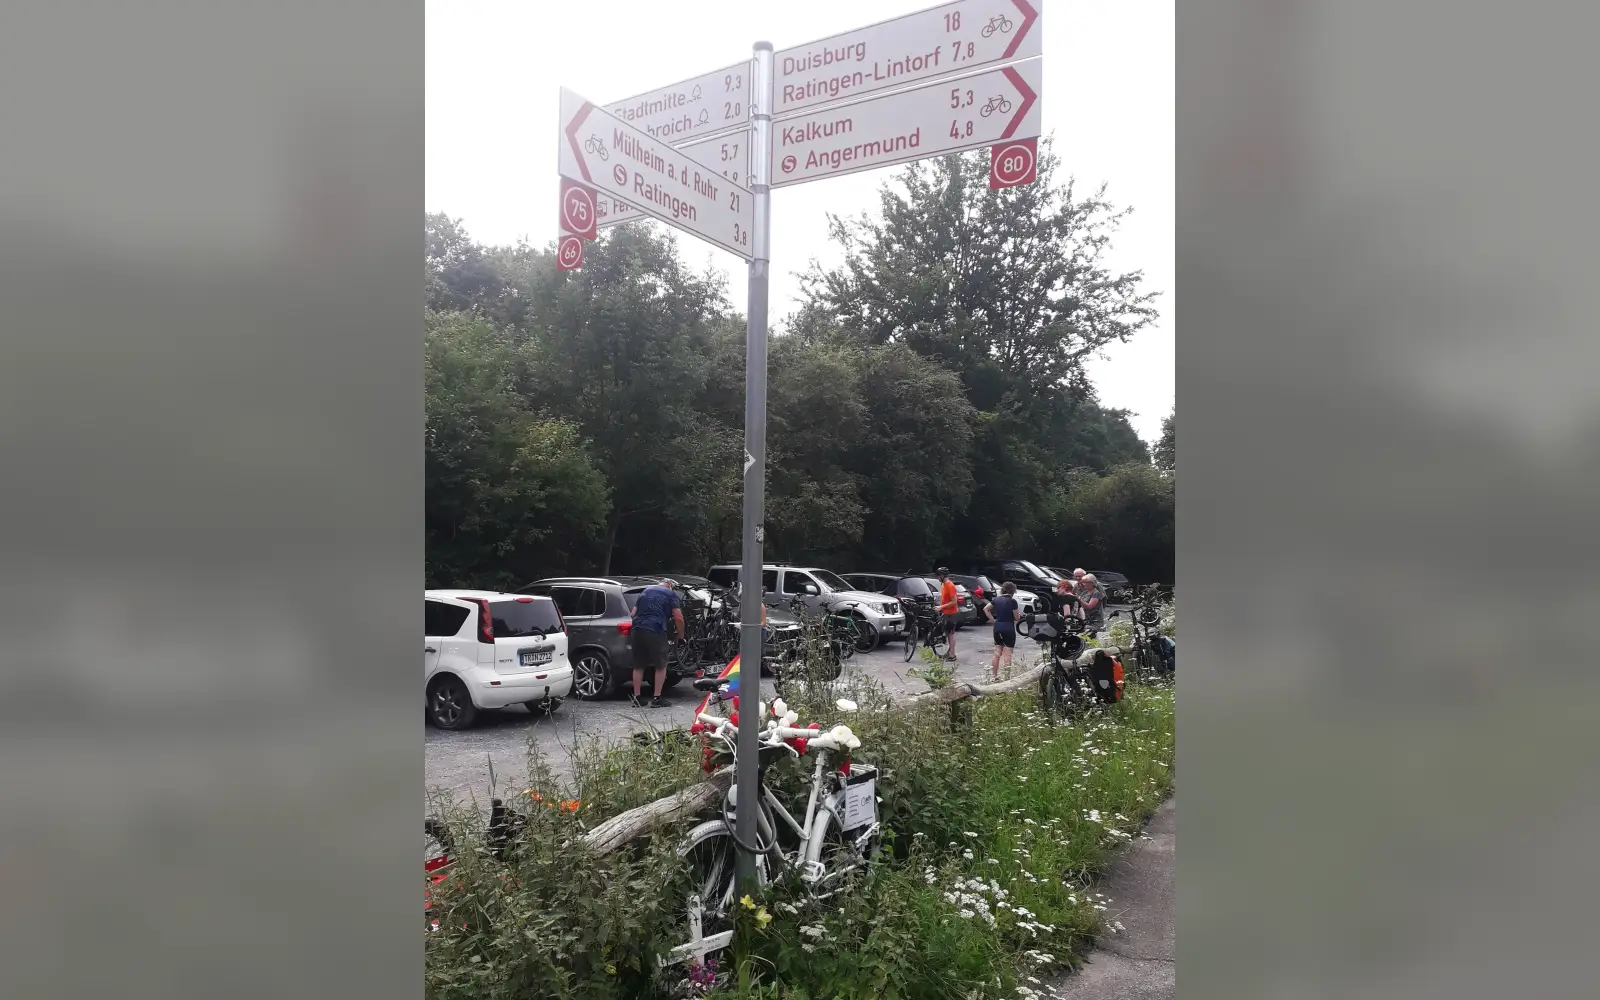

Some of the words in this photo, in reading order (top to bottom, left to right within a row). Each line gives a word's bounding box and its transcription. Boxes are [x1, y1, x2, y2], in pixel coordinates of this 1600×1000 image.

[783, 41, 866, 76] Duisburg
[943, 10, 961, 33] 18
[783, 45, 941, 104] Ratingen-Lintorf
[952, 41, 975, 62] 7,8
[614, 91, 686, 121] Stadtmitte
[950, 88, 974, 109] 5,3
[782, 117, 853, 146] Kalkum
[950, 119, 973, 140] 4,8
[805, 128, 920, 170] Angermund
[1003, 155, 1024, 173] 80
[613, 127, 665, 175] Mülheim
[668, 162, 677, 181] a.
[681, 165, 691, 188] d.
[694, 176, 719, 202] Ruhr
[730, 191, 740, 213] 21
[571, 198, 587, 221] 75
[634, 172, 697, 222] Ratingen
[564, 245, 576, 259] 66
